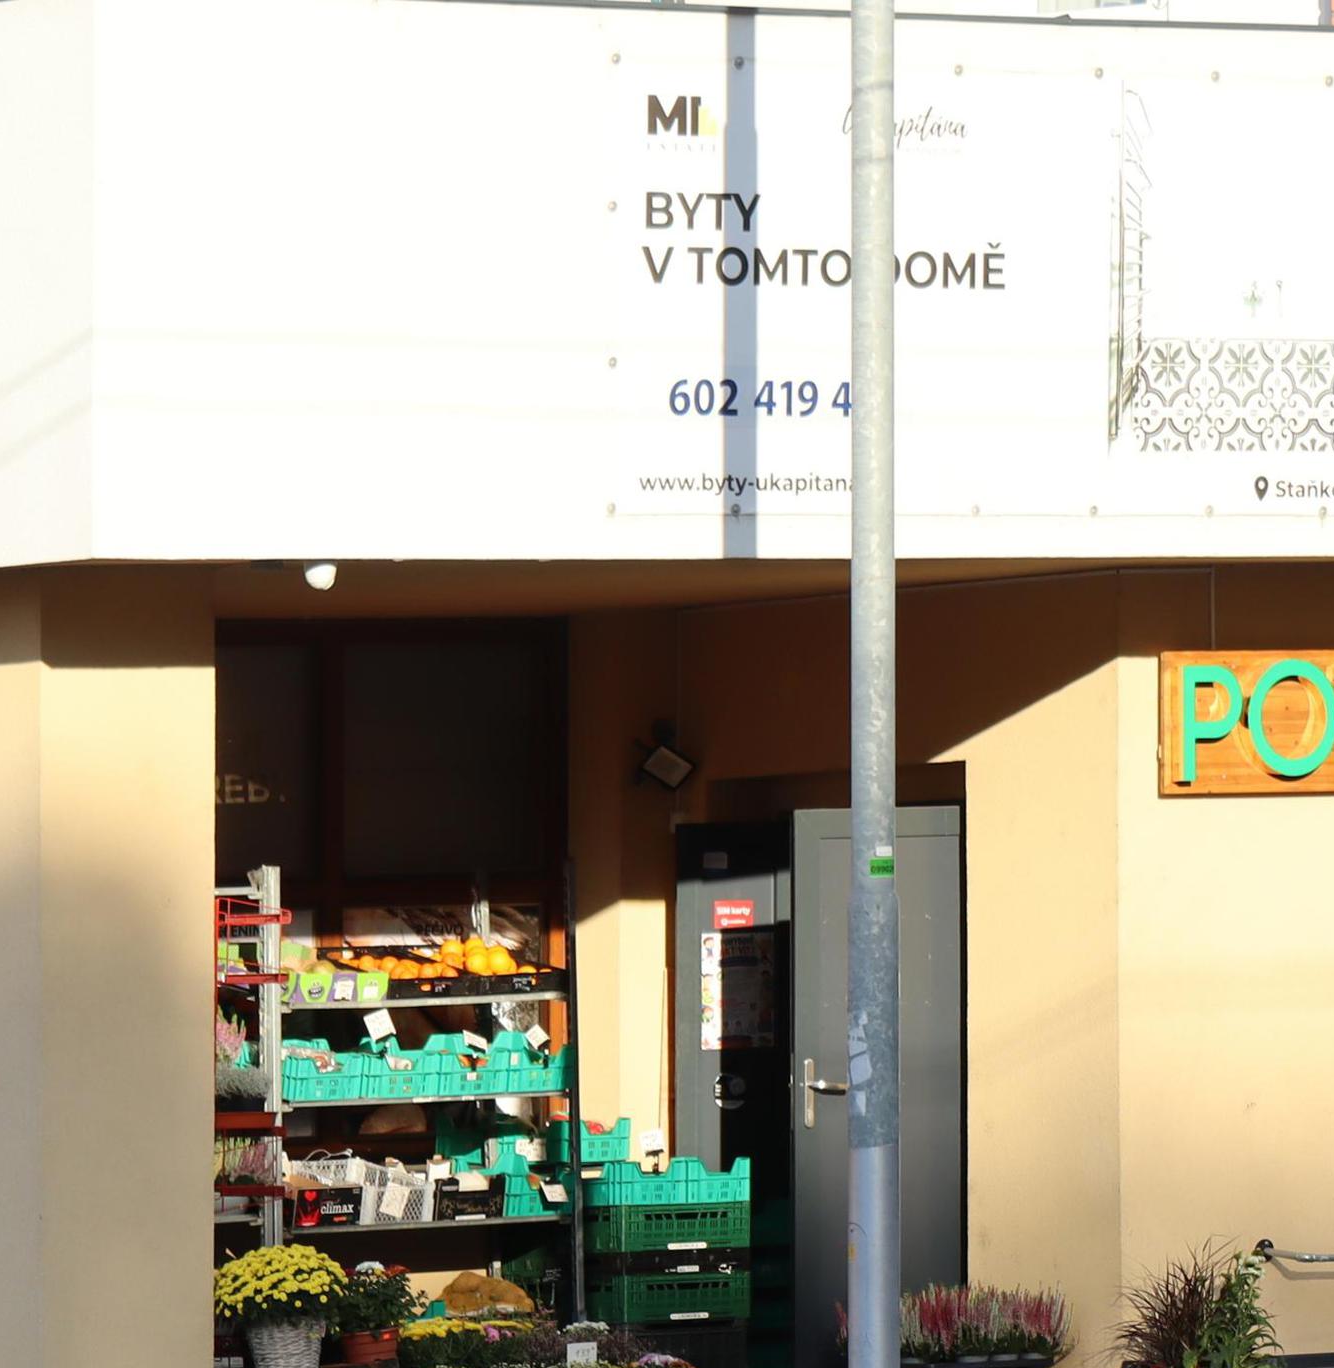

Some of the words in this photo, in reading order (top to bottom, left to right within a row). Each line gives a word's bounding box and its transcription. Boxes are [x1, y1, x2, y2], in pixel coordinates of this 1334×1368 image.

[644, 192, 761, 231] BYTY
[642, 247, 675, 284] V
[687, 247, 852, 287] TOMTO
[669, 379, 739, 417] 602
[754, 380, 819, 417] 419
